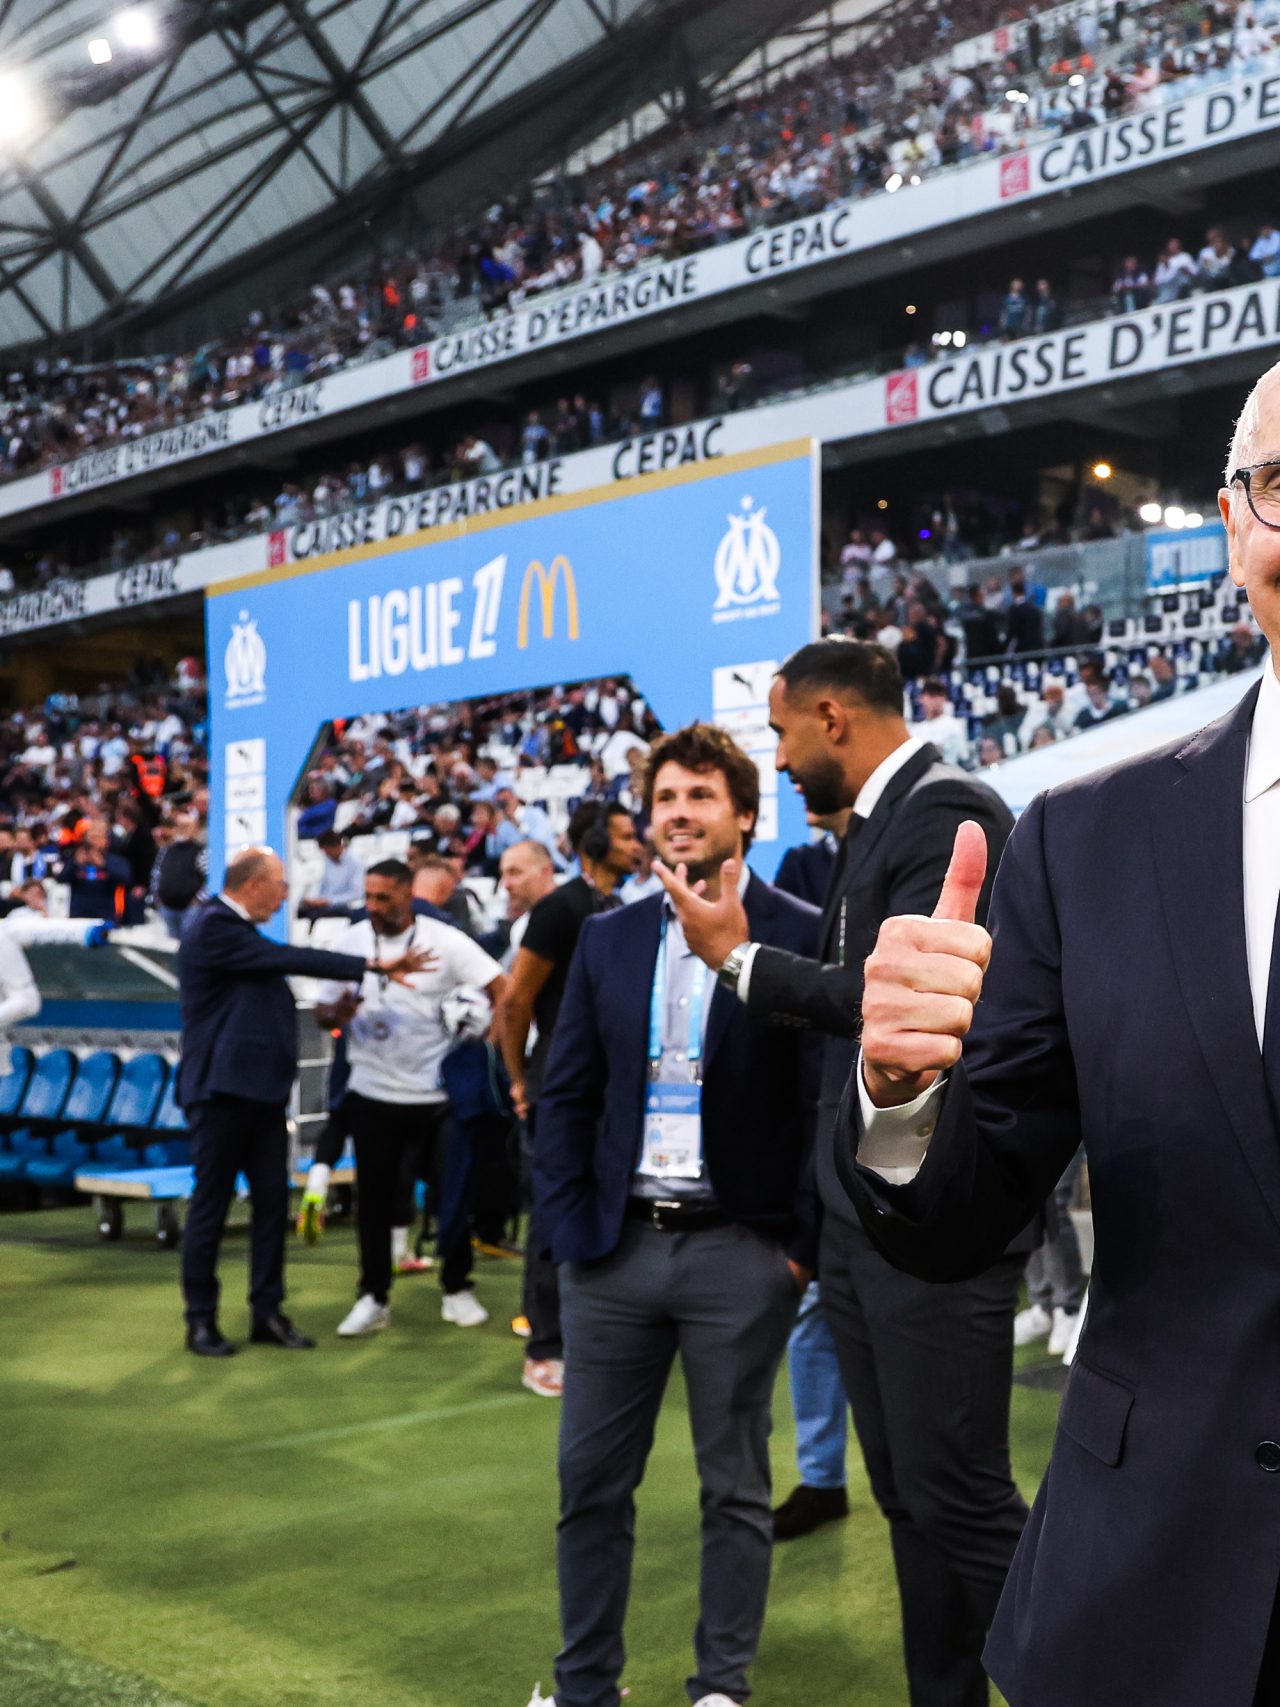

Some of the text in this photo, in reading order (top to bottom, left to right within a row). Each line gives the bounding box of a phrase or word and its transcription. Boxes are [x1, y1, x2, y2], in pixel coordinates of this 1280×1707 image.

[1039, 106, 1186, 183] CAISSE
[433, 320, 515, 372] CAISSE
[745, 209, 850, 274] CEPAC
[928, 332, 1087, 409] CAISSE
[291, 505, 376, 559] CAISSE
[612, 420, 725, 481] CEPAC
[348, 577, 465, 682] LIGUE
